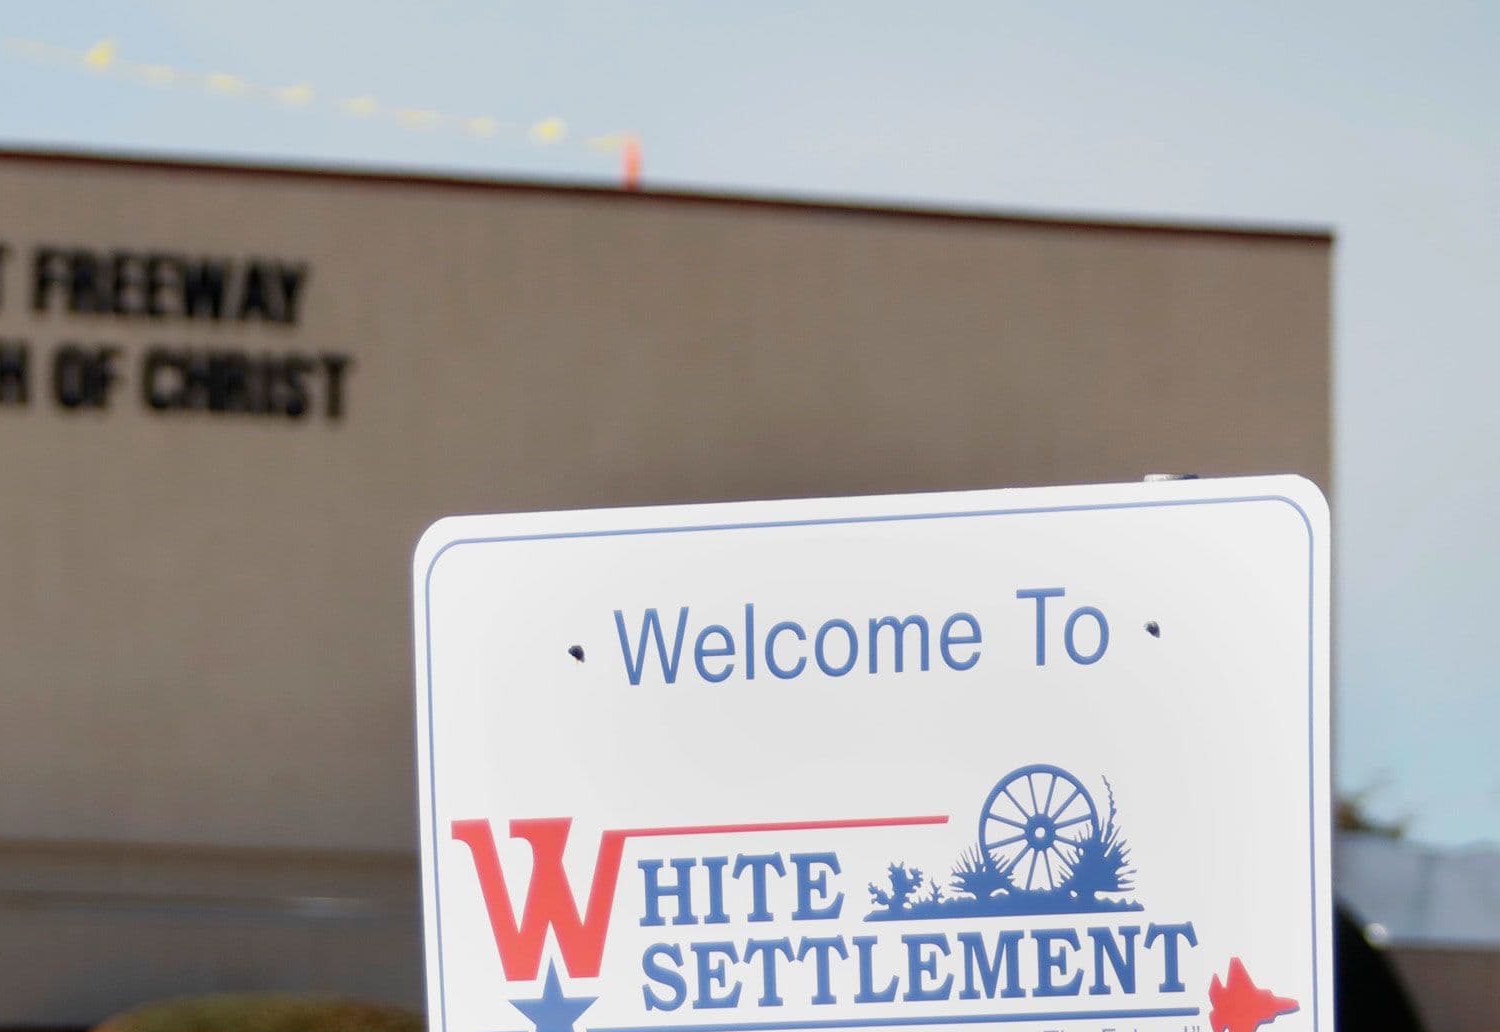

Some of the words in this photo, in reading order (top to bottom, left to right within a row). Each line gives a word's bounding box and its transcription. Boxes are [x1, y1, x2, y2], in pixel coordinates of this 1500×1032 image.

[30, 246, 308, 327] FREEWAY
[49, 343, 126, 411] OF
[139, 347, 352, 420] CHRIST
[613, 602, 983, 687] Welcome
[1015, 586, 1112, 667] To
[451, 816, 846, 983] WHITE
[640, 921, 1199, 1014] SETTLEMENT
